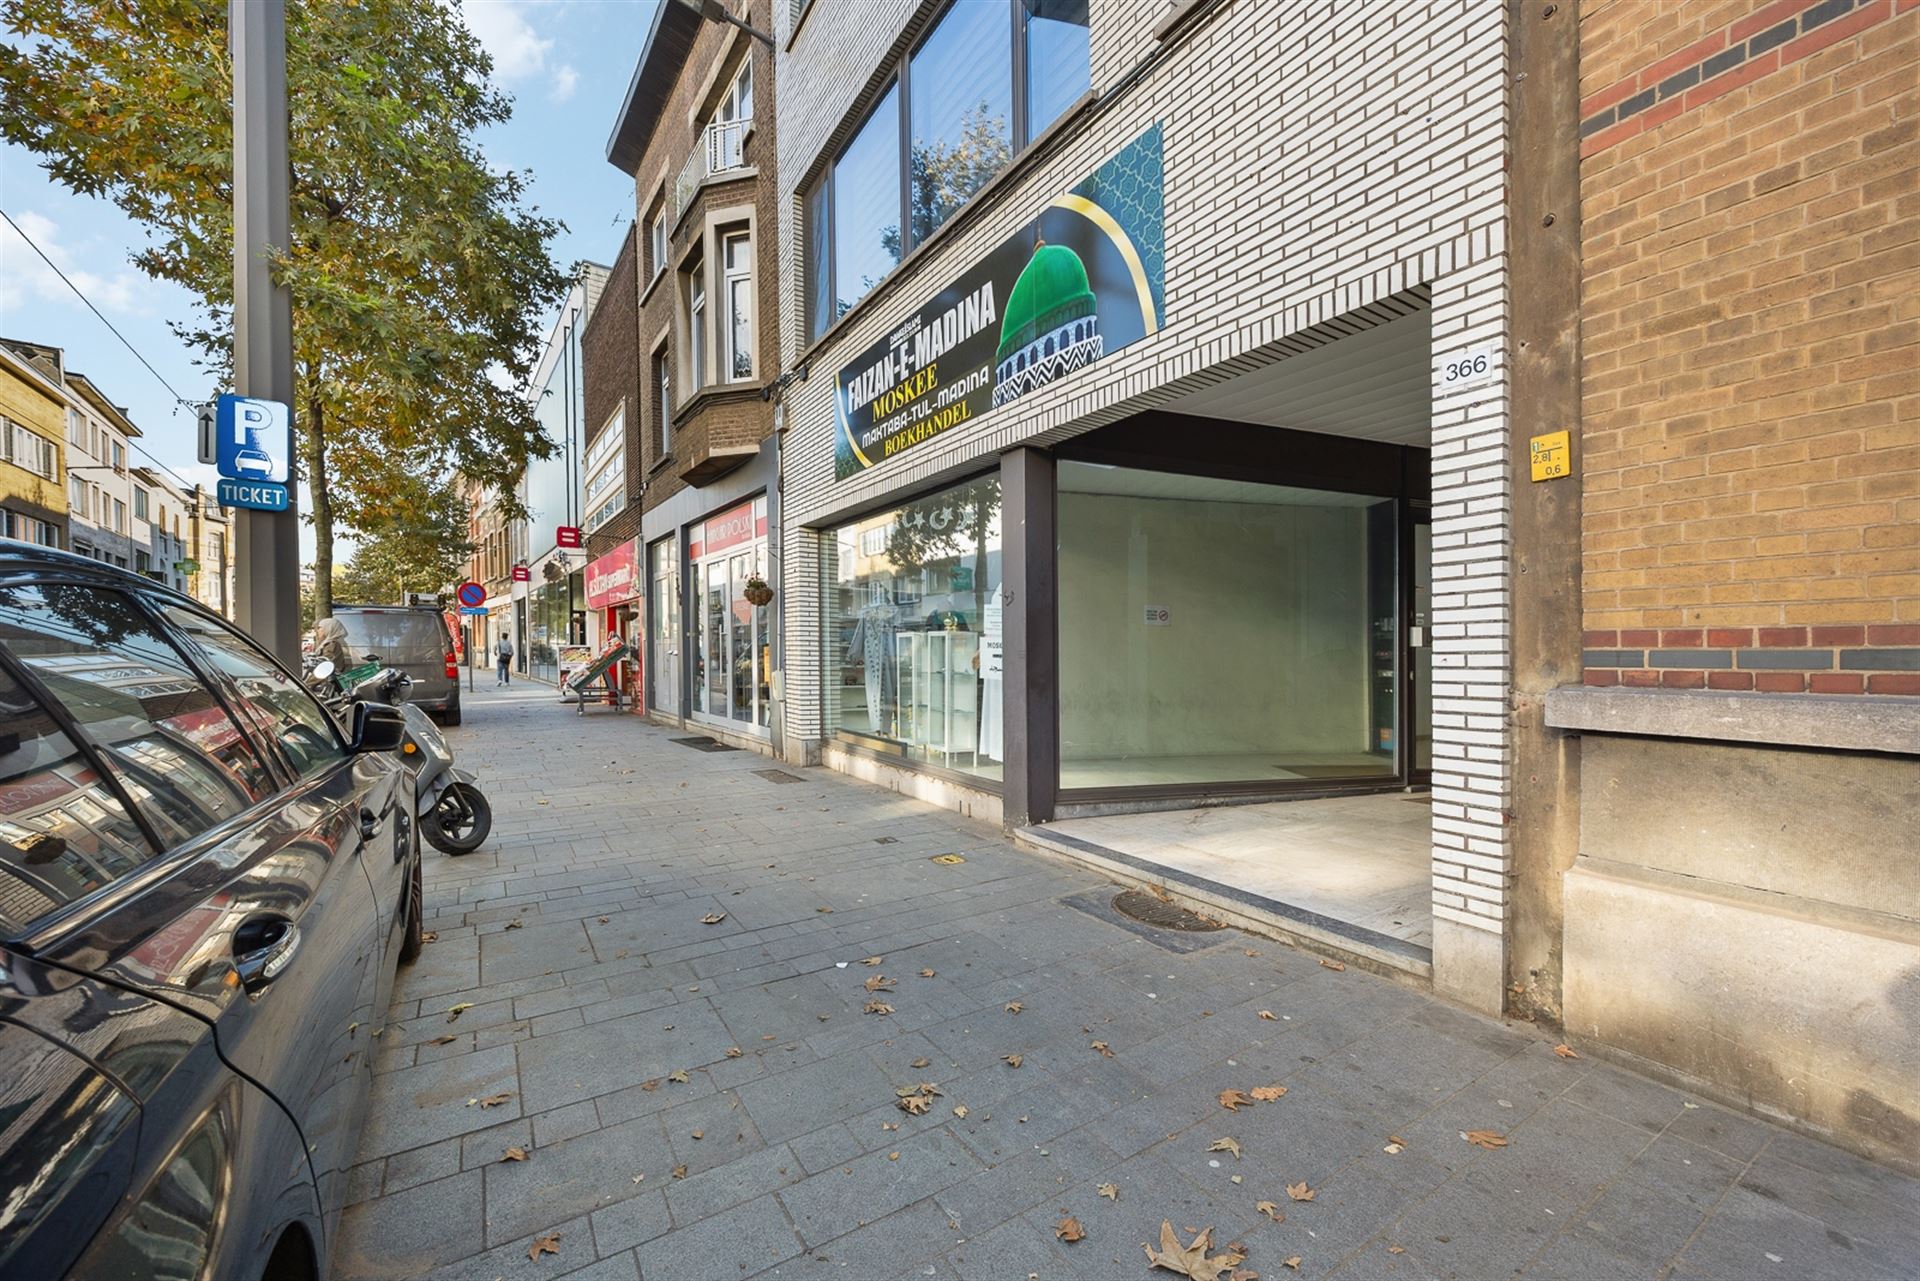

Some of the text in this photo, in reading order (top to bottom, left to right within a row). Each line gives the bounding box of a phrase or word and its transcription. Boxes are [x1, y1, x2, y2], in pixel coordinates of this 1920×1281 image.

[848, 280, 996, 415] FAIZAN-E-MADINA
[1446, 355, 1487, 381] 366
[862, 365, 989, 449] MAKTABA-TUL-MADINA
[872, 363, 938, 422] MOSKEE
[234, 401, 273, 445] P
[884, 400, 971, 457] BOEKHANDEL
[222, 484, 283, 505] TICKET
